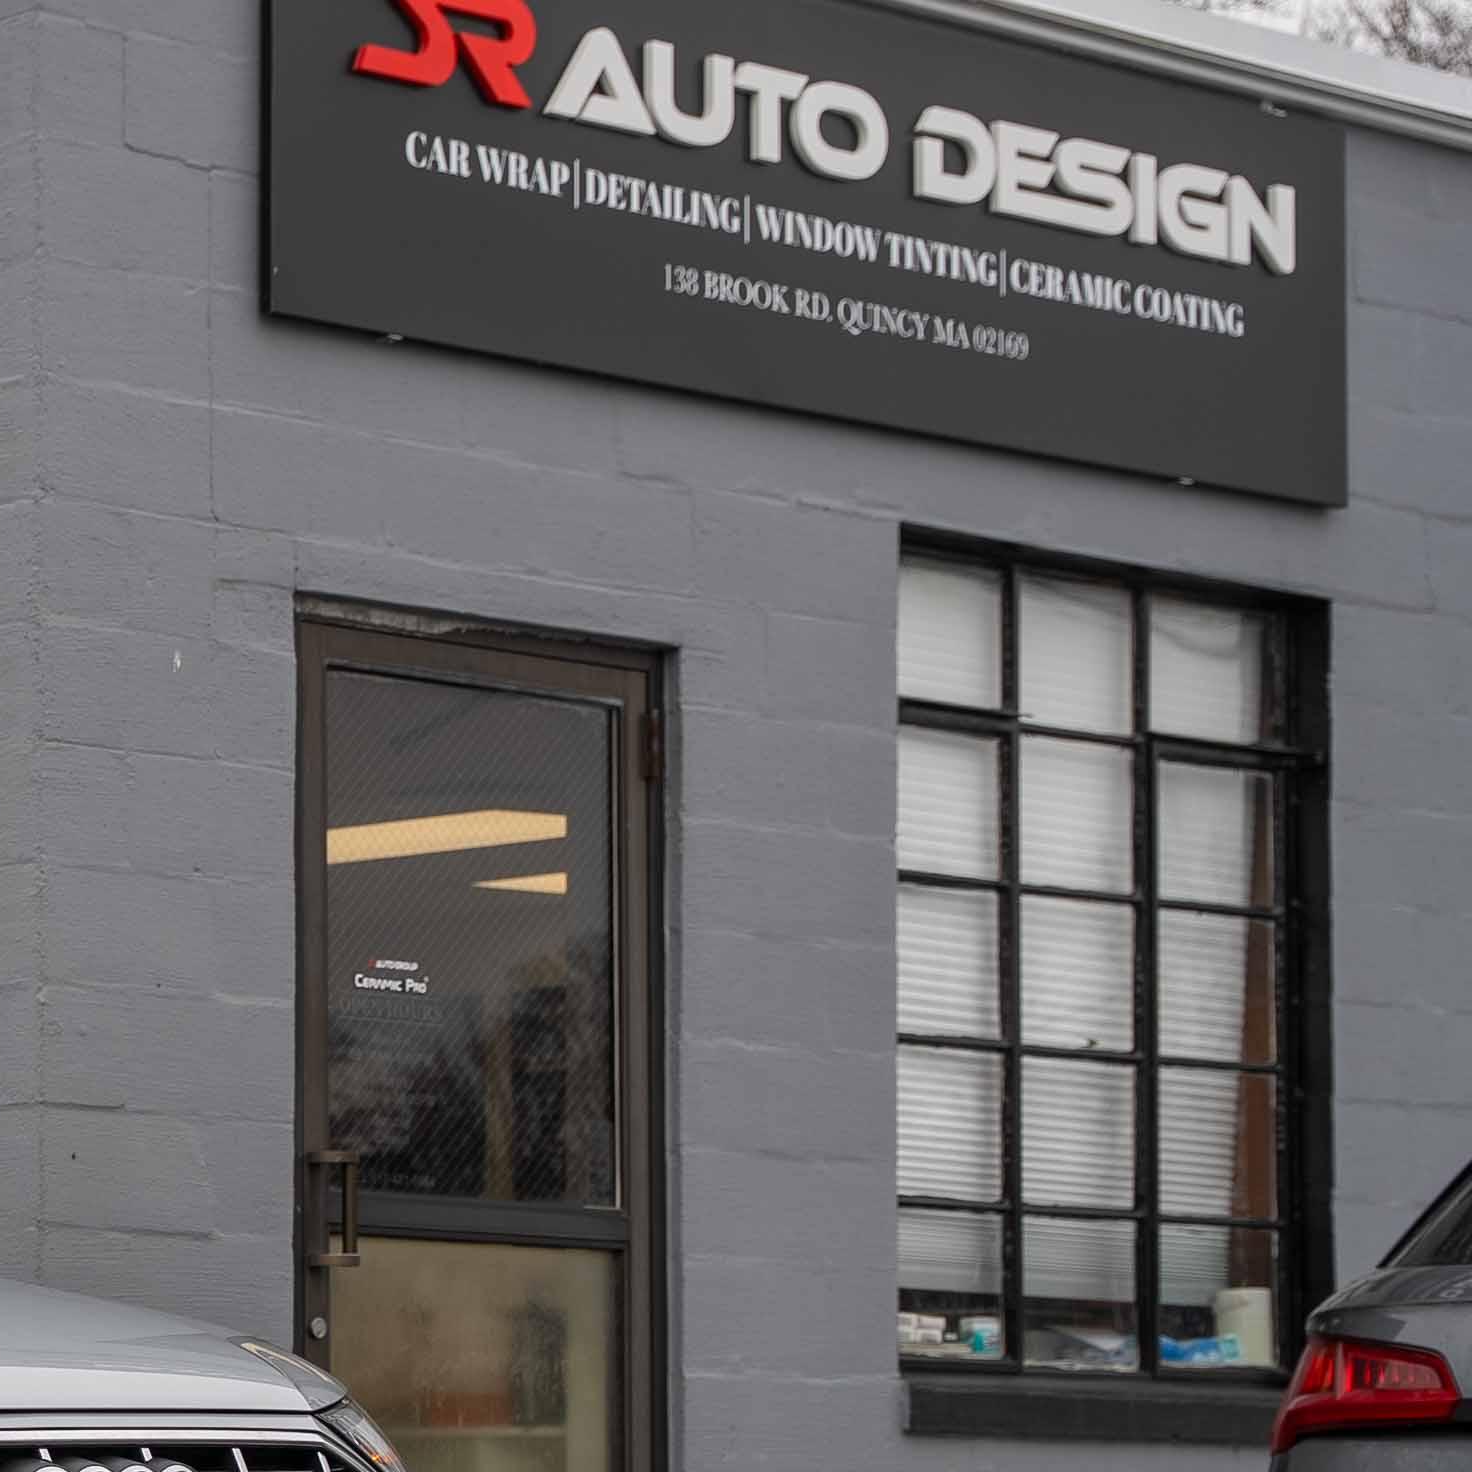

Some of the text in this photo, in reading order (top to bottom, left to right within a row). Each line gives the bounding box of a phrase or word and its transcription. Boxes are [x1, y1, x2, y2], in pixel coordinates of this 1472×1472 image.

[404, 130, 1246, 338] CAR WRAP DETAILING WINDOW TINTING CERAMIC COATING
[542, 26, 889, 181] AUTO
[912, 104, 1296, 275] DESIGN
[664, 262, 700, 296] 138
[704, 270, 791, 314] BROOK
[836, 296, 931, 341] QUINCY
[932, 314, 970, 350] MA
[972, 324, 1030, 361] 02169
